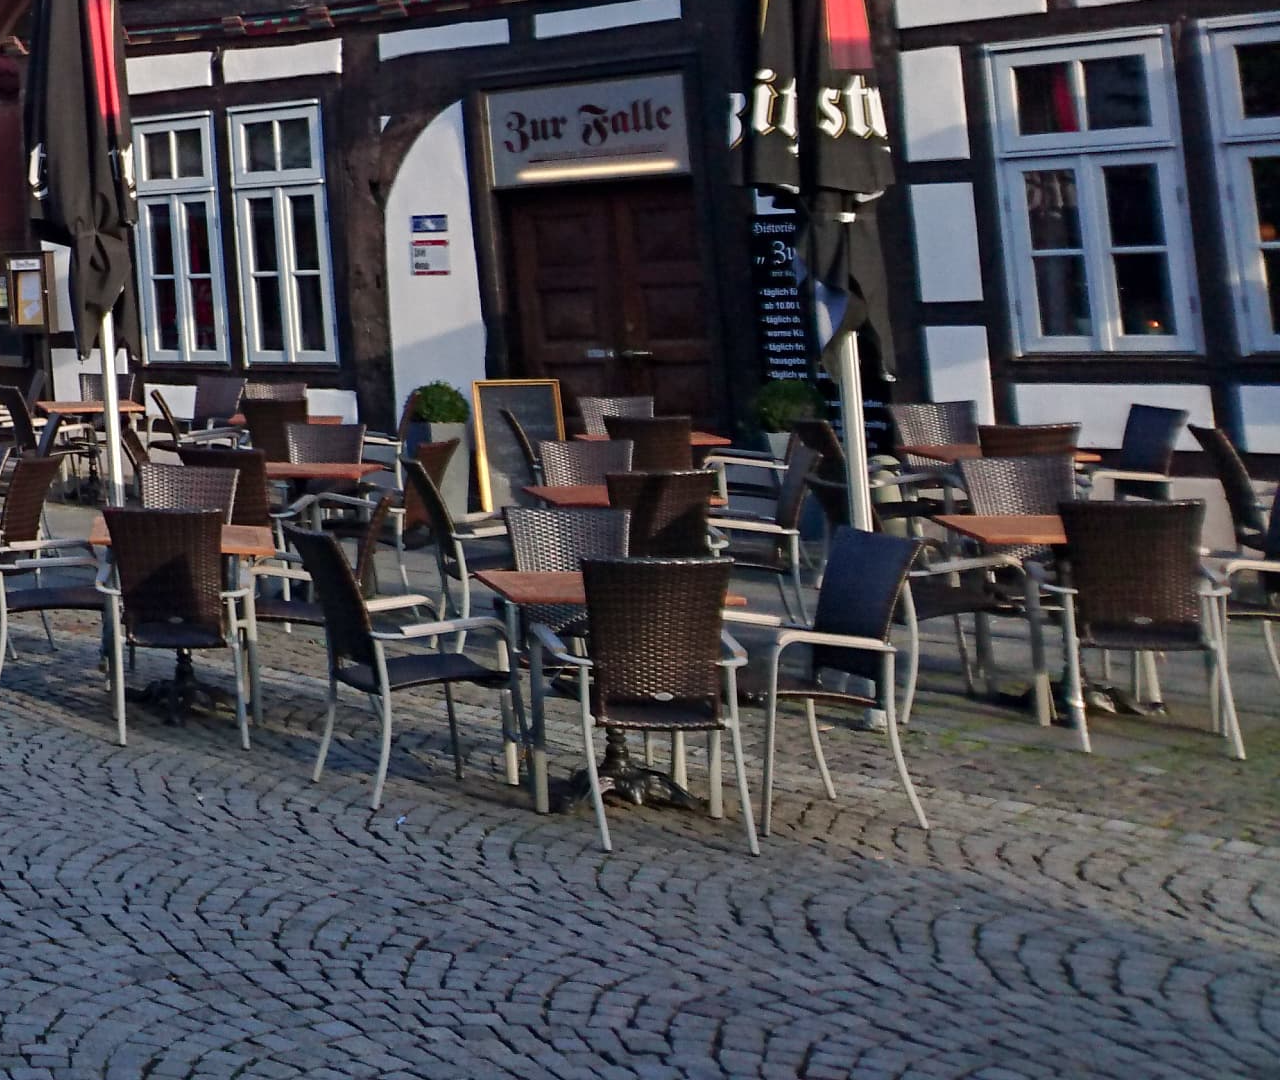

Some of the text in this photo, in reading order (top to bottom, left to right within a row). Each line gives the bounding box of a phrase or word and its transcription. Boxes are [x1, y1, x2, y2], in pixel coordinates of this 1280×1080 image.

[503, 111, 567, 154] Zur
[752, 222, 796, 234] Historis
[769, 357, 806, 366] hausgeba
